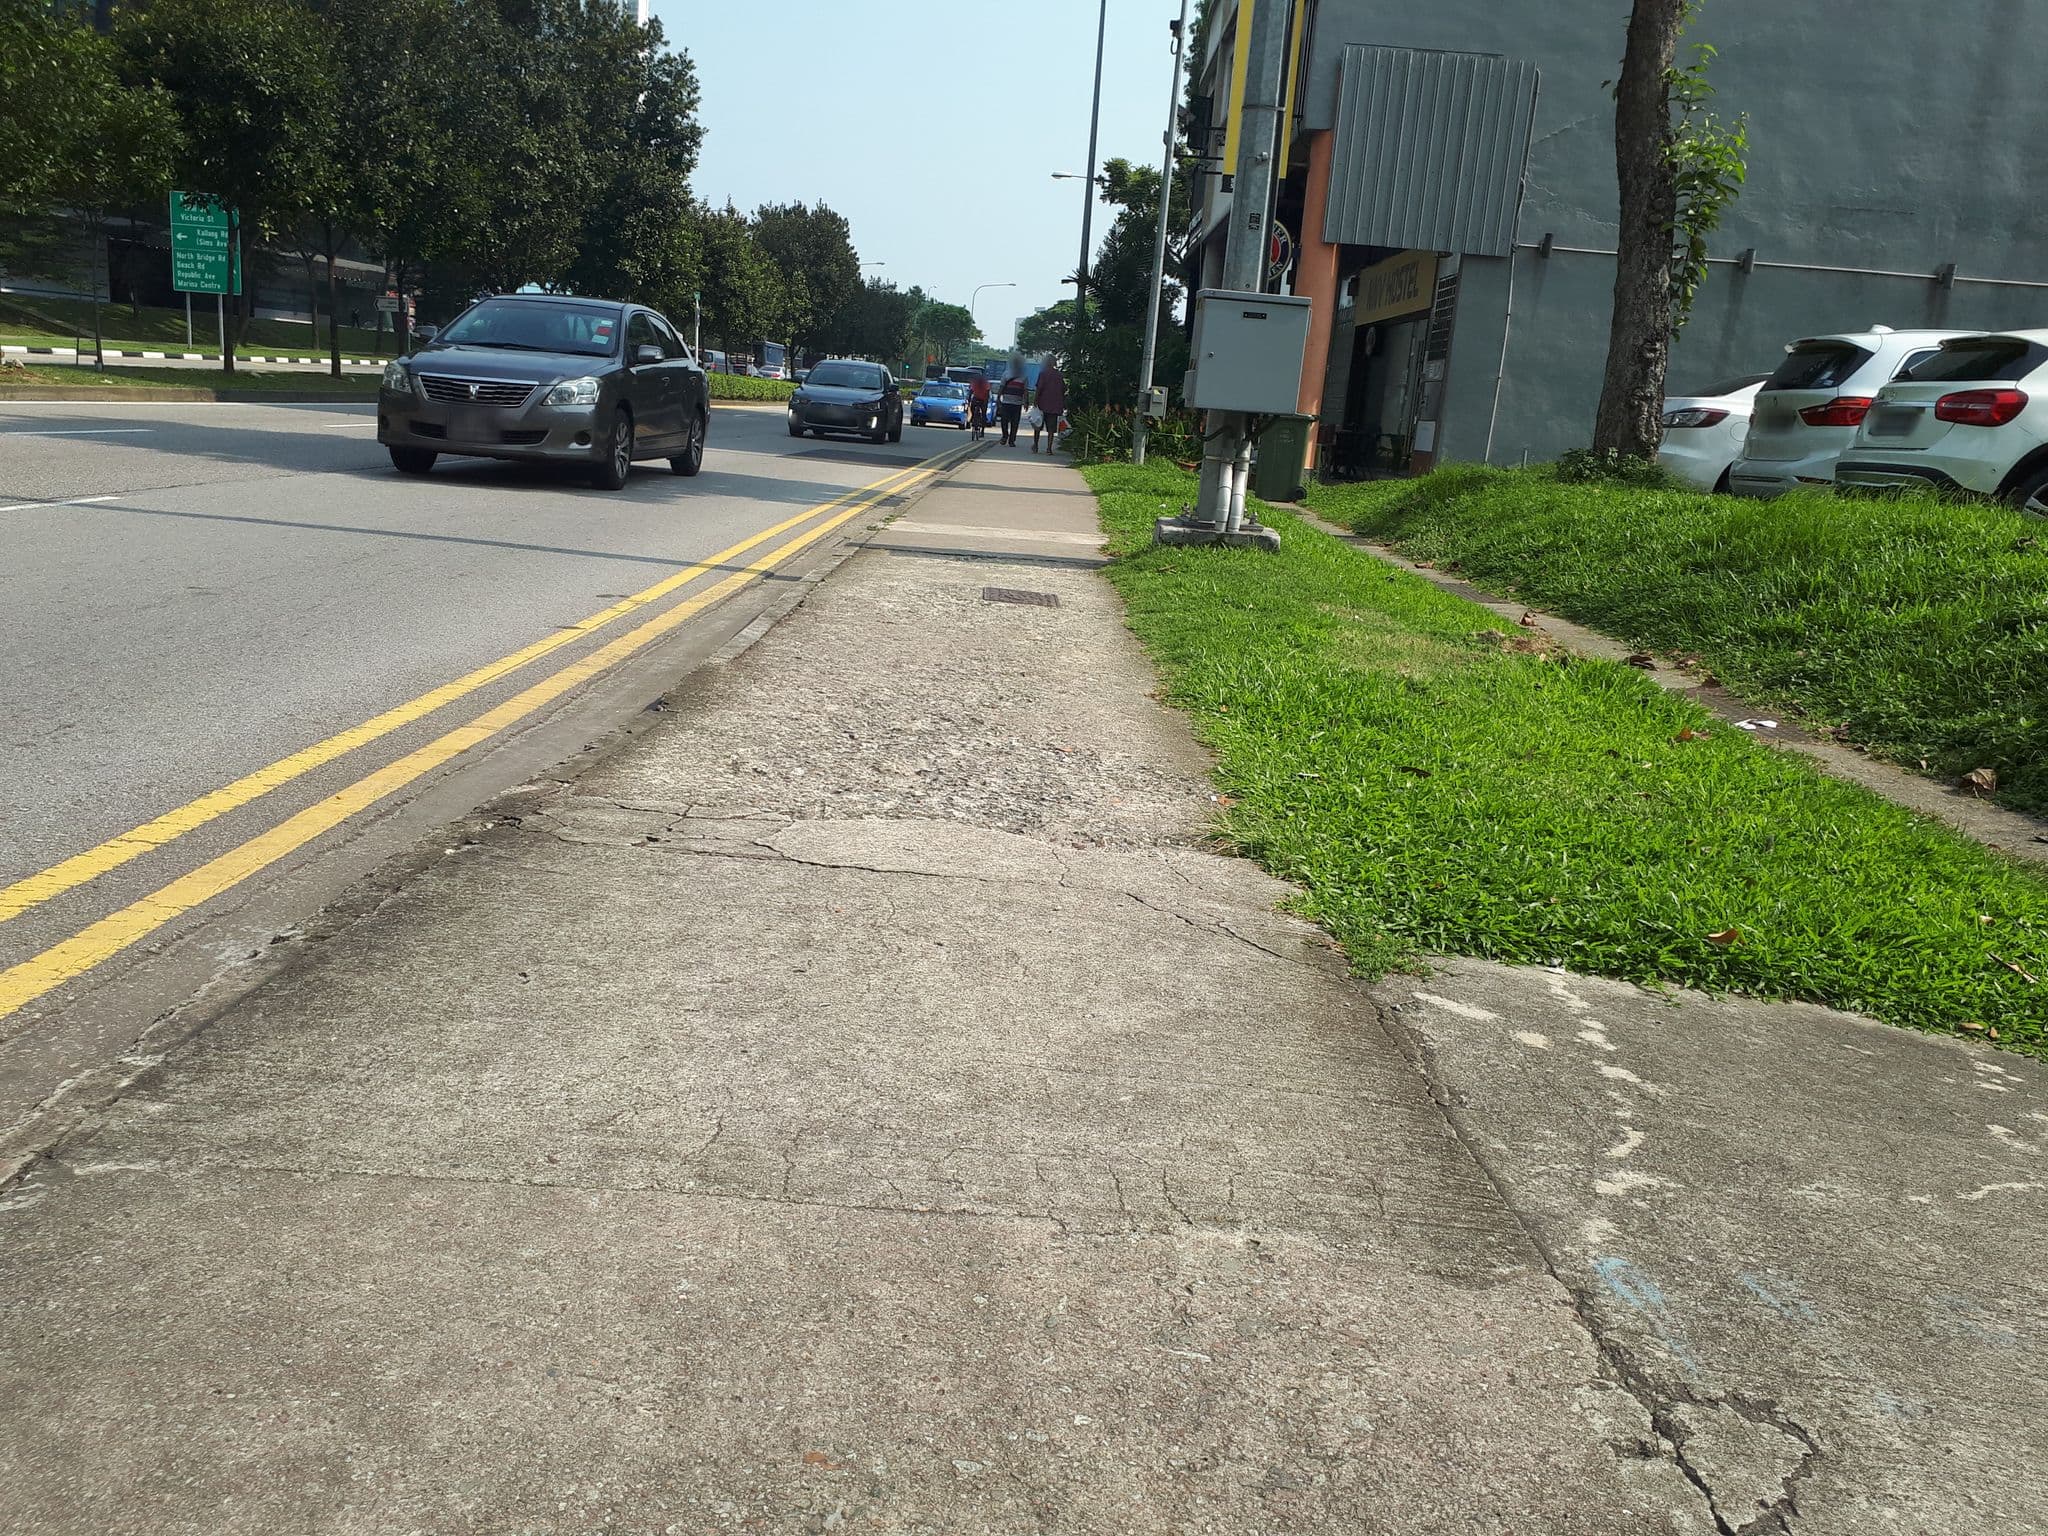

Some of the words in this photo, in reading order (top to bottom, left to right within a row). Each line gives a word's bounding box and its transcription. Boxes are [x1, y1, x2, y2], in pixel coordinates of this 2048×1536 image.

[181, 214, 205, 222] Victoria
[197, 229, 218, 239] Kallang
[197, 253, 215, 262] Bridge
[177, 261, 194, 269] Beach
[197, 262, 205, 270] Rd
[177, 270, 201, 279] Republic
[1385, 262, 1419, 305] HOSTEL
